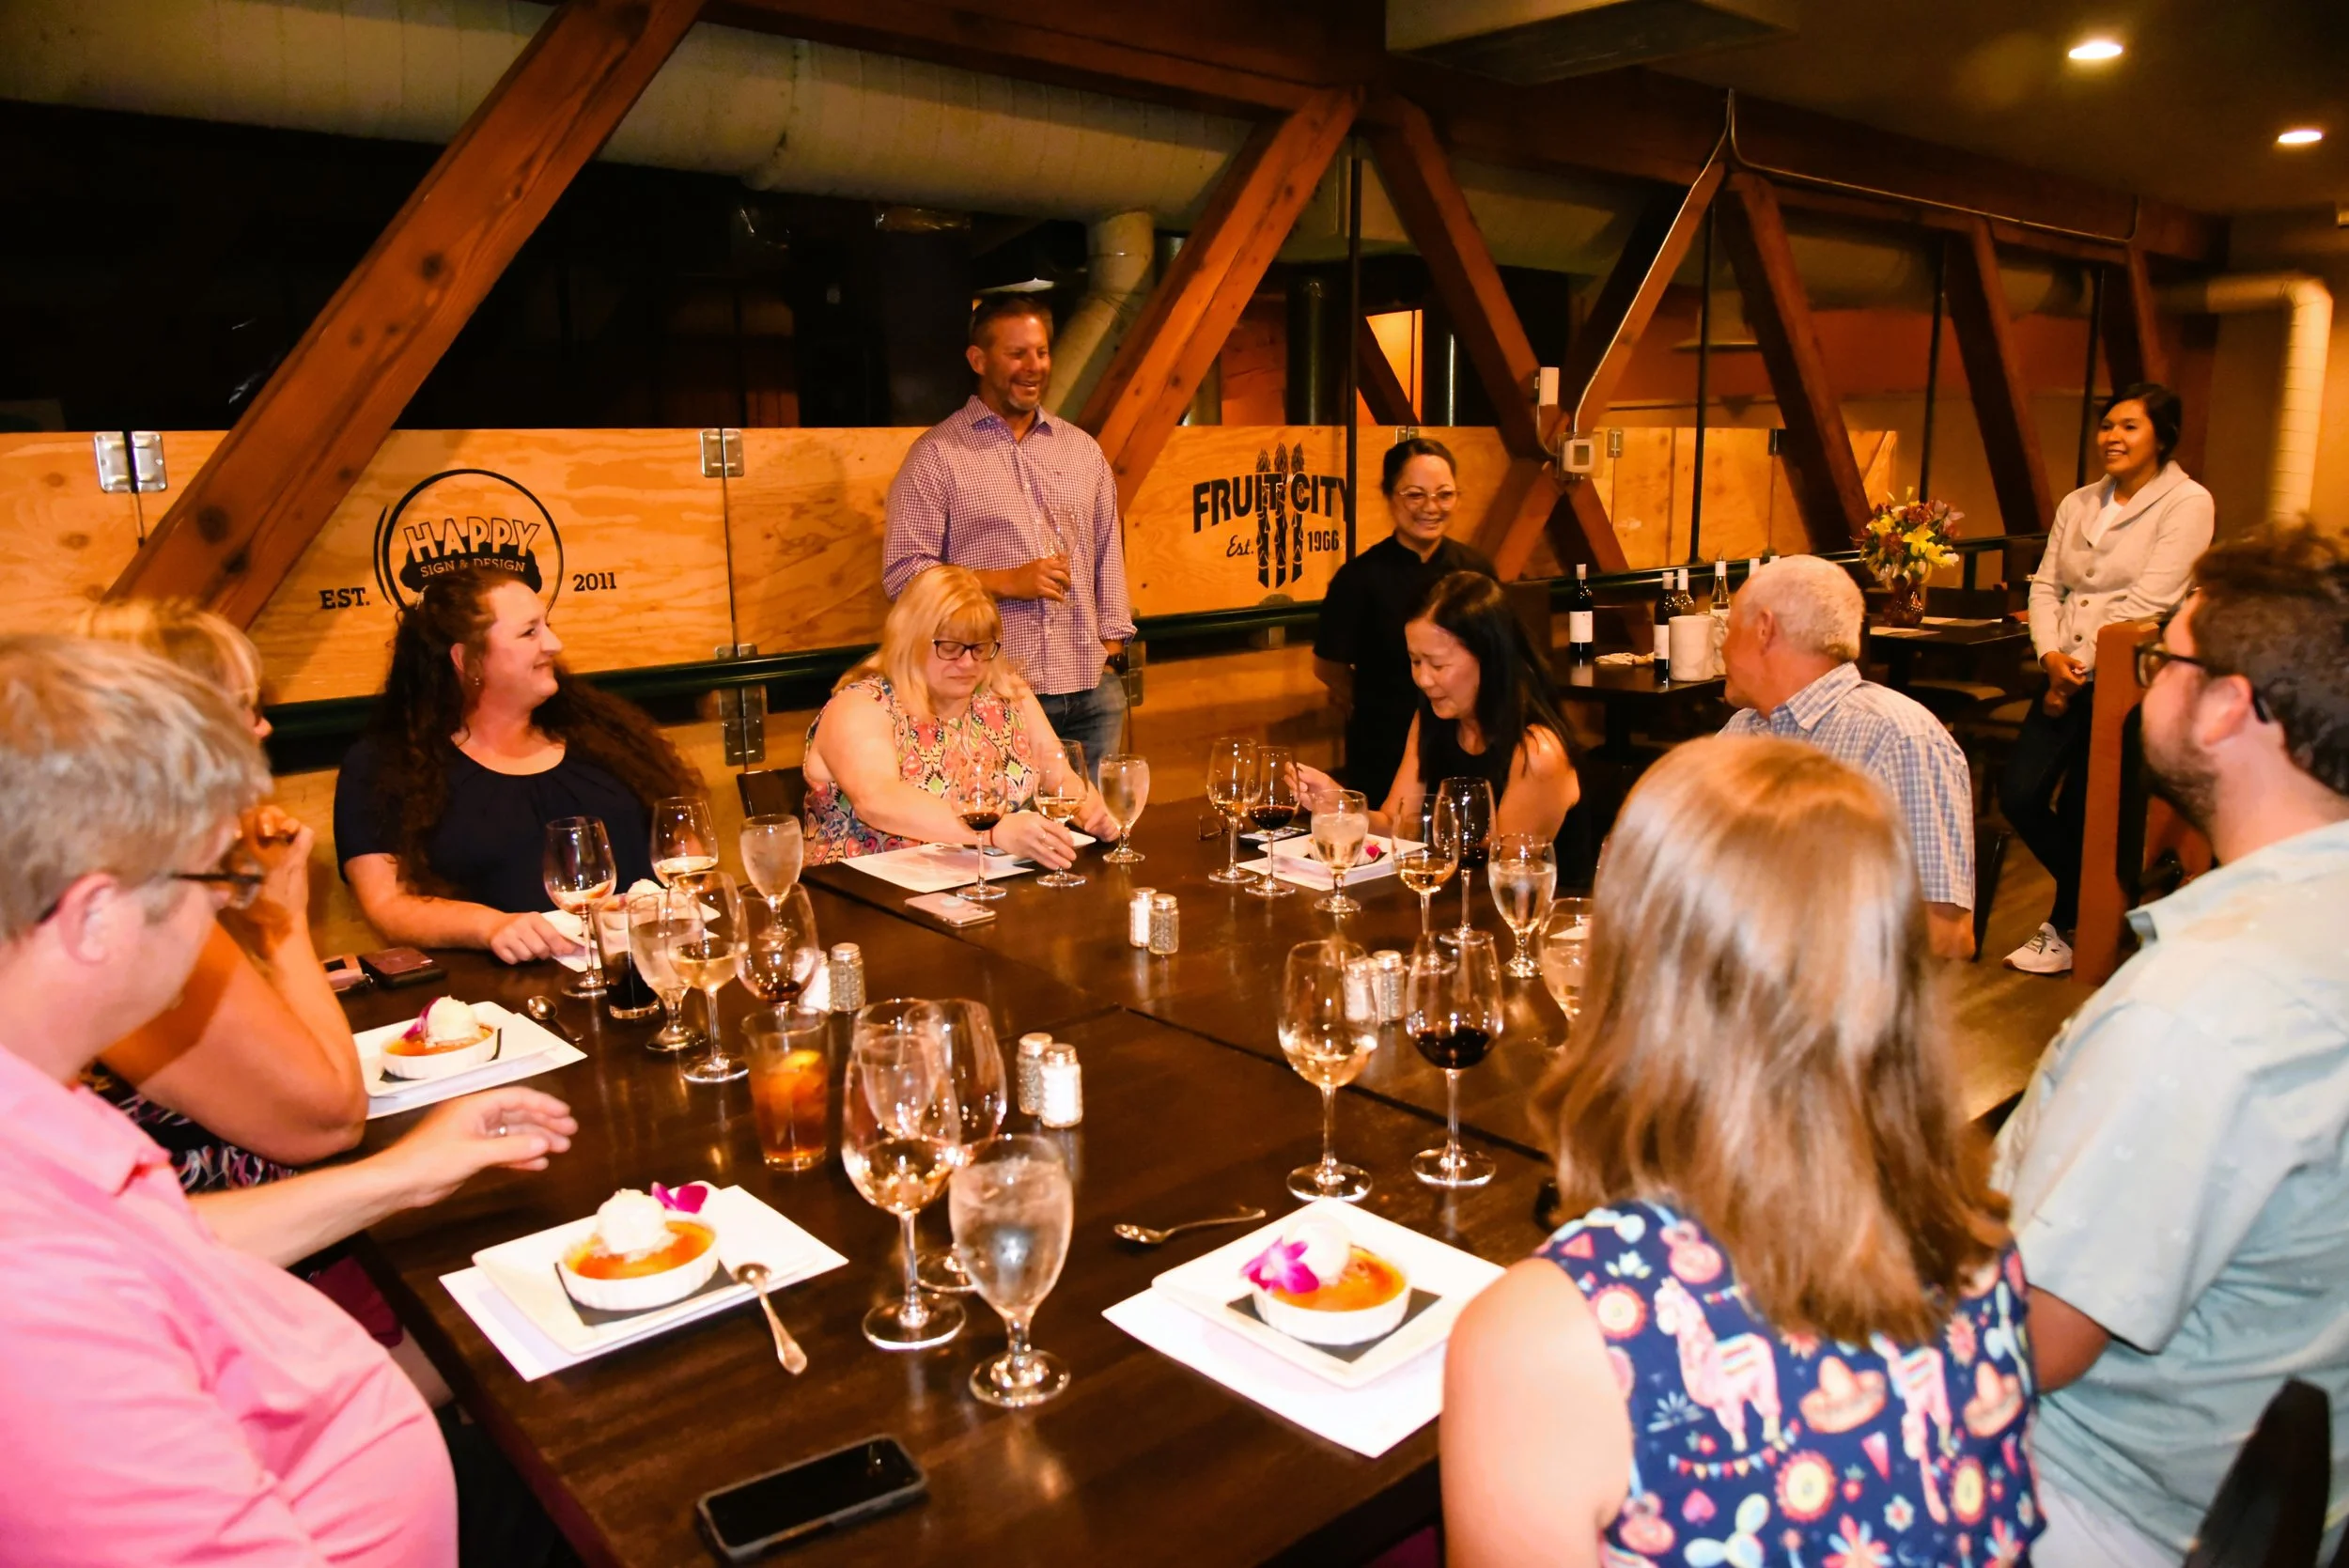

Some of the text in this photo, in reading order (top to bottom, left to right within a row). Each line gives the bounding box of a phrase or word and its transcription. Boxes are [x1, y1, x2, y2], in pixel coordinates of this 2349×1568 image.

[1193, 473, 1283, 534] FRUIT
[404, 517, 540, 563] HAPPY
[1226, 530, 1340, 558] Est. 1966
[420, 560, 456, 578] SIGN
[319, 572, 617, 609] EST. 2011
